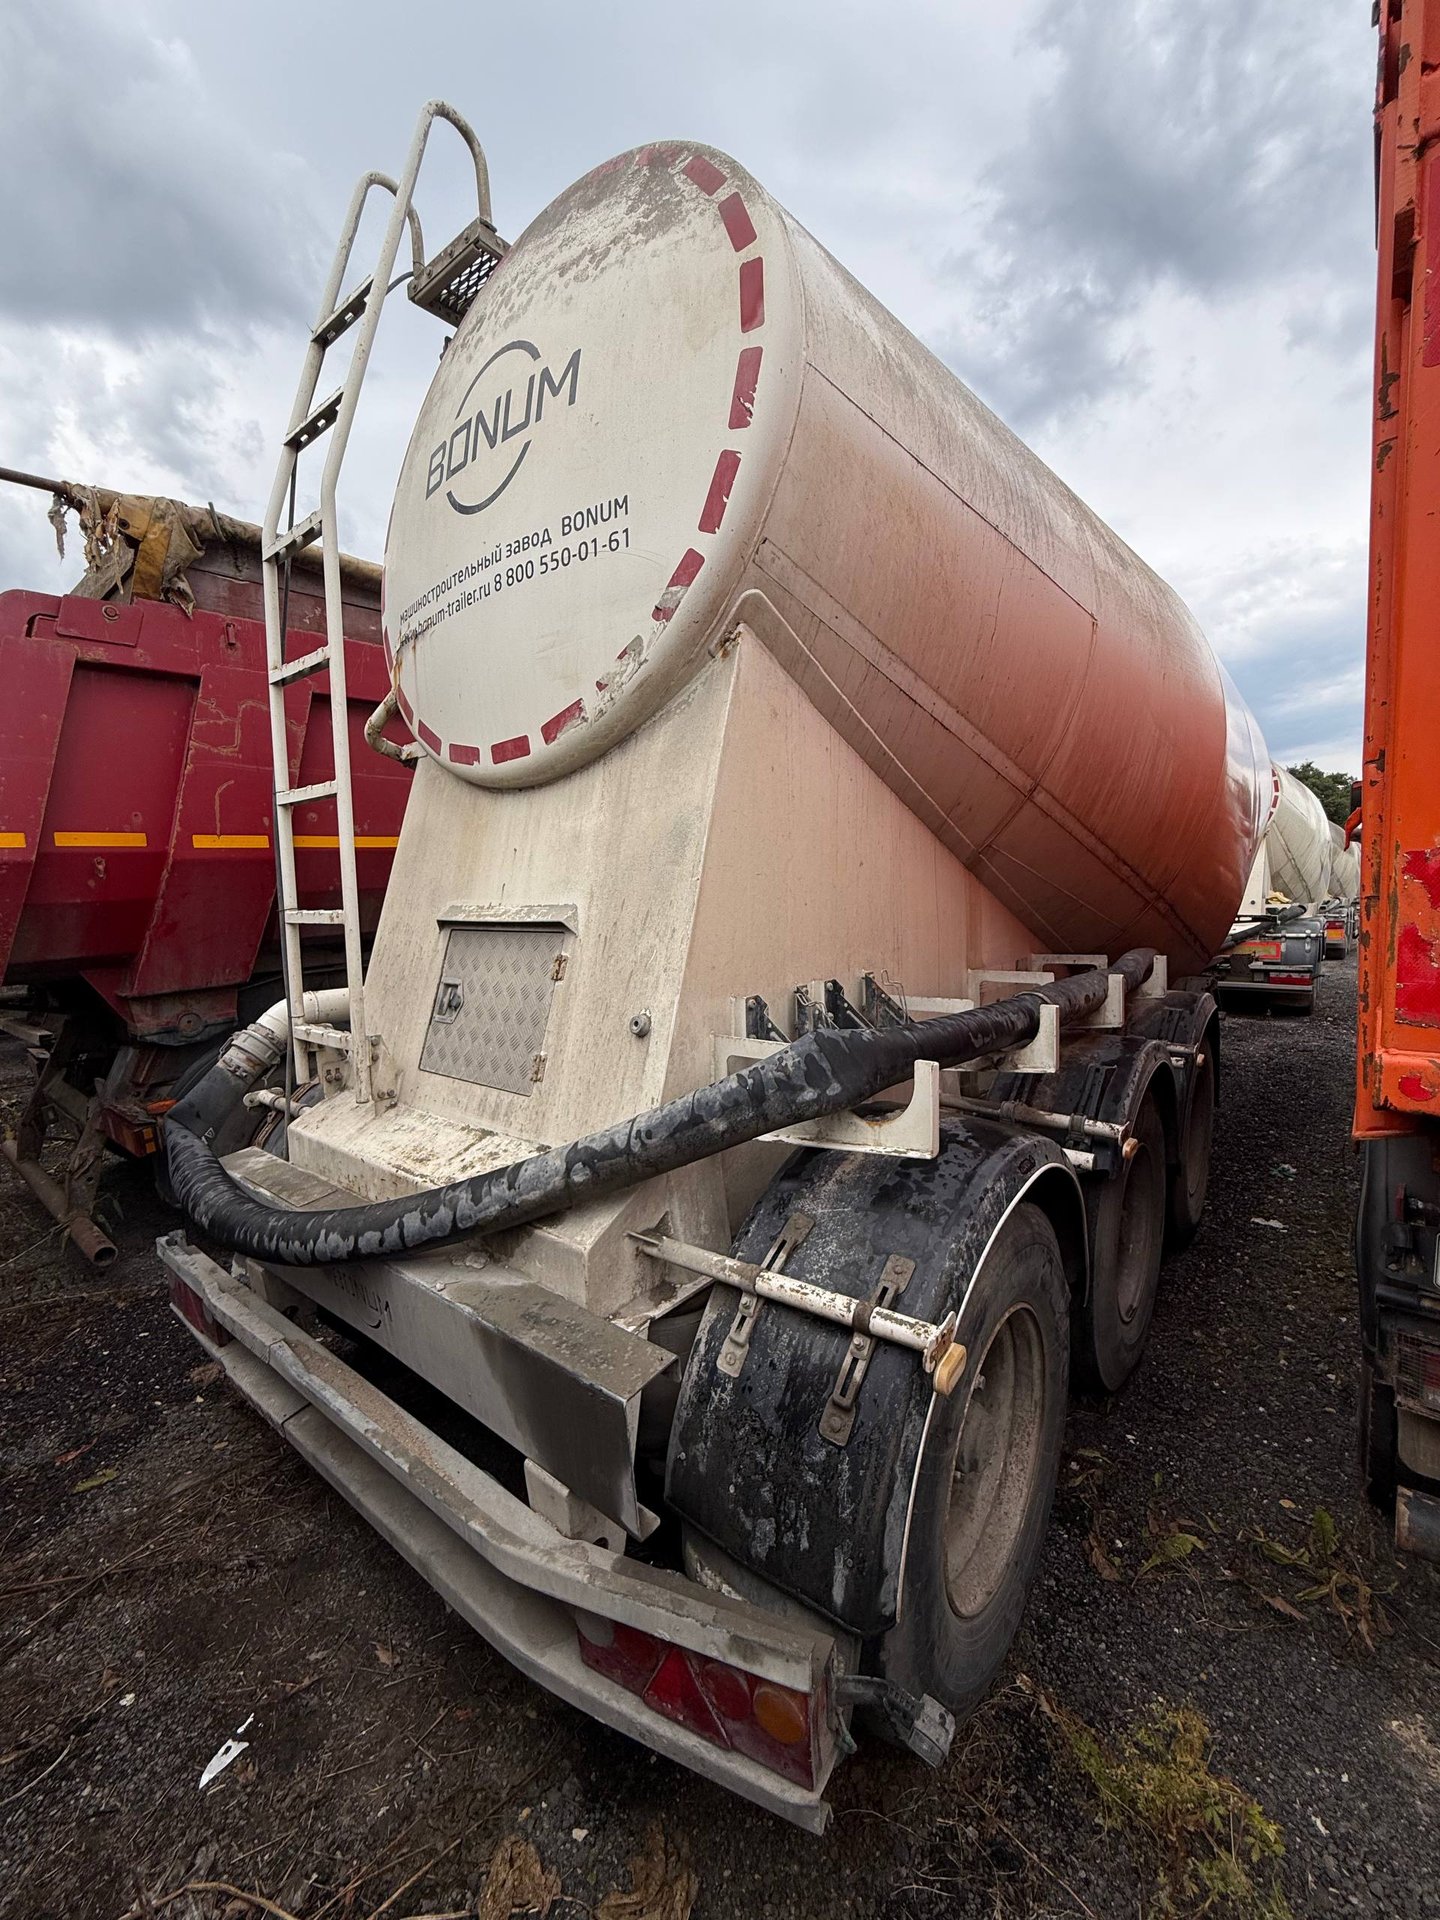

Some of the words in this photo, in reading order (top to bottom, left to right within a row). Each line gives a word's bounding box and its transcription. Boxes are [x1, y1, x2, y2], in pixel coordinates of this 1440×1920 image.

[425, 348, 582, 501] BONUM
[400, 544, 502, 625] машиностроительный
[505, 527, 552, 559] завод
[561, 494, 629, 537] BONUM
[494, 572, 503, 592] 8
[506, 560, 534, 588] 800
[539, 527, 630, 576] 550-01-61
